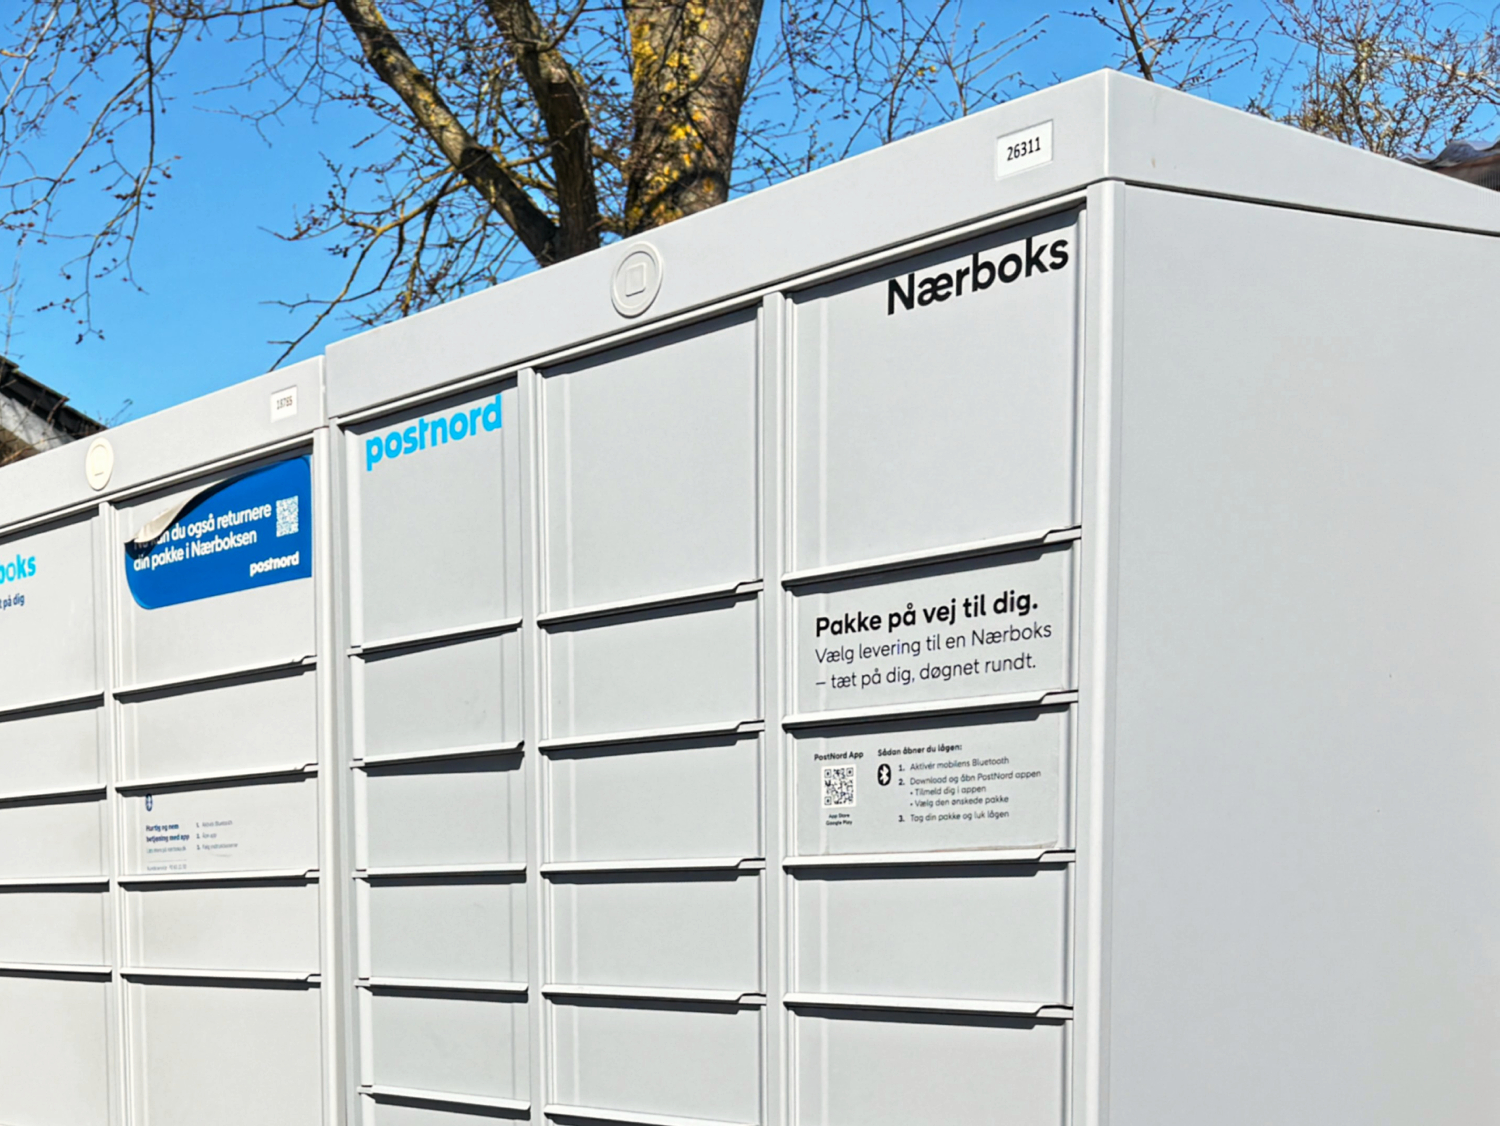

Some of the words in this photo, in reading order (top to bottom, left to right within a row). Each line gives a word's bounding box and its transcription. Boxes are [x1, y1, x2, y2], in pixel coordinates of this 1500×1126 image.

[1007, 136, 1041, 161] 26311
[887, 237, 1069, 316] Nærboks
[366, 393, 502, 472] postnord
[171, 522, 186, 541] du
[187, 513, 215, 539] også
[217, 504, 272, 529] returnere
[133, 553, 150, 571] din
[151, 546, 184, 571] pakke
[185, 542, 190, 559] i
[191, 530, 257, 558] Nærboksen
[249, 551, 300, 577] postnord
[3, 595, 12, 610] på
[13, 593, 25, 606] dig
[816, 611, 882, 637] Pakke
[888, 602, 917, 633] på
[923, 598, 956, 625] vej
[963, 594, 986, 618] til
[993, 590, 1038, 616] dig.
[815, 646, 855, 665] Vælg
[859, 639, 921, 660] levering
[925, 633, 941, 651] til
[945, 634, 966, 649] en
[971, 622, 1052, 647] Nærboks
[831, 672, 857, 689] tæt
[861, 668, 882, 690] på
[886, 666, 915, 685] dig,
[919, 657, 980, 681] døgnet
[985, 652, 1036, 673] rundt.
[814, 751, 848, 761] PostNord
[849, 751, 864, 760] App
[877, 748, 901, 757] Sådan
[902, 746, 925, 755] åbner
[926, 745, 937, 753] du
[898, 764, 905, 772] 1.
[937, 760, 970, 769] mobilens
[972, 756, 1009, 767] Bluetooth
[898, 778, 905, 786] 2.
[910, 776, 947, 785] Download
[948, 776, 959, 785] og
[960, 773, 975, 782] åbn
[977, 771, 1013, 781] PostNord
[1015, 770, 1041, 780] appen
[914, 788, 942, 796] Tilmeld
[943, 786, 956, 796] dig
[961, 785, 987, 795] appen
[914, 799, 934, 808] Vælg
[935, 799, 950, 807] den
[951, 797, 983, 806] ønskede
[984, 795, 1009, 805] pakke
[910, 814, 924, 823] Tag
[925, 813, 937, 821] din
[938, 811, 961, 821] pakke
[962, 812, 972, 820] og
[974, 811, 985, 819] luk
[987, 810, 1009, 819] lågen
